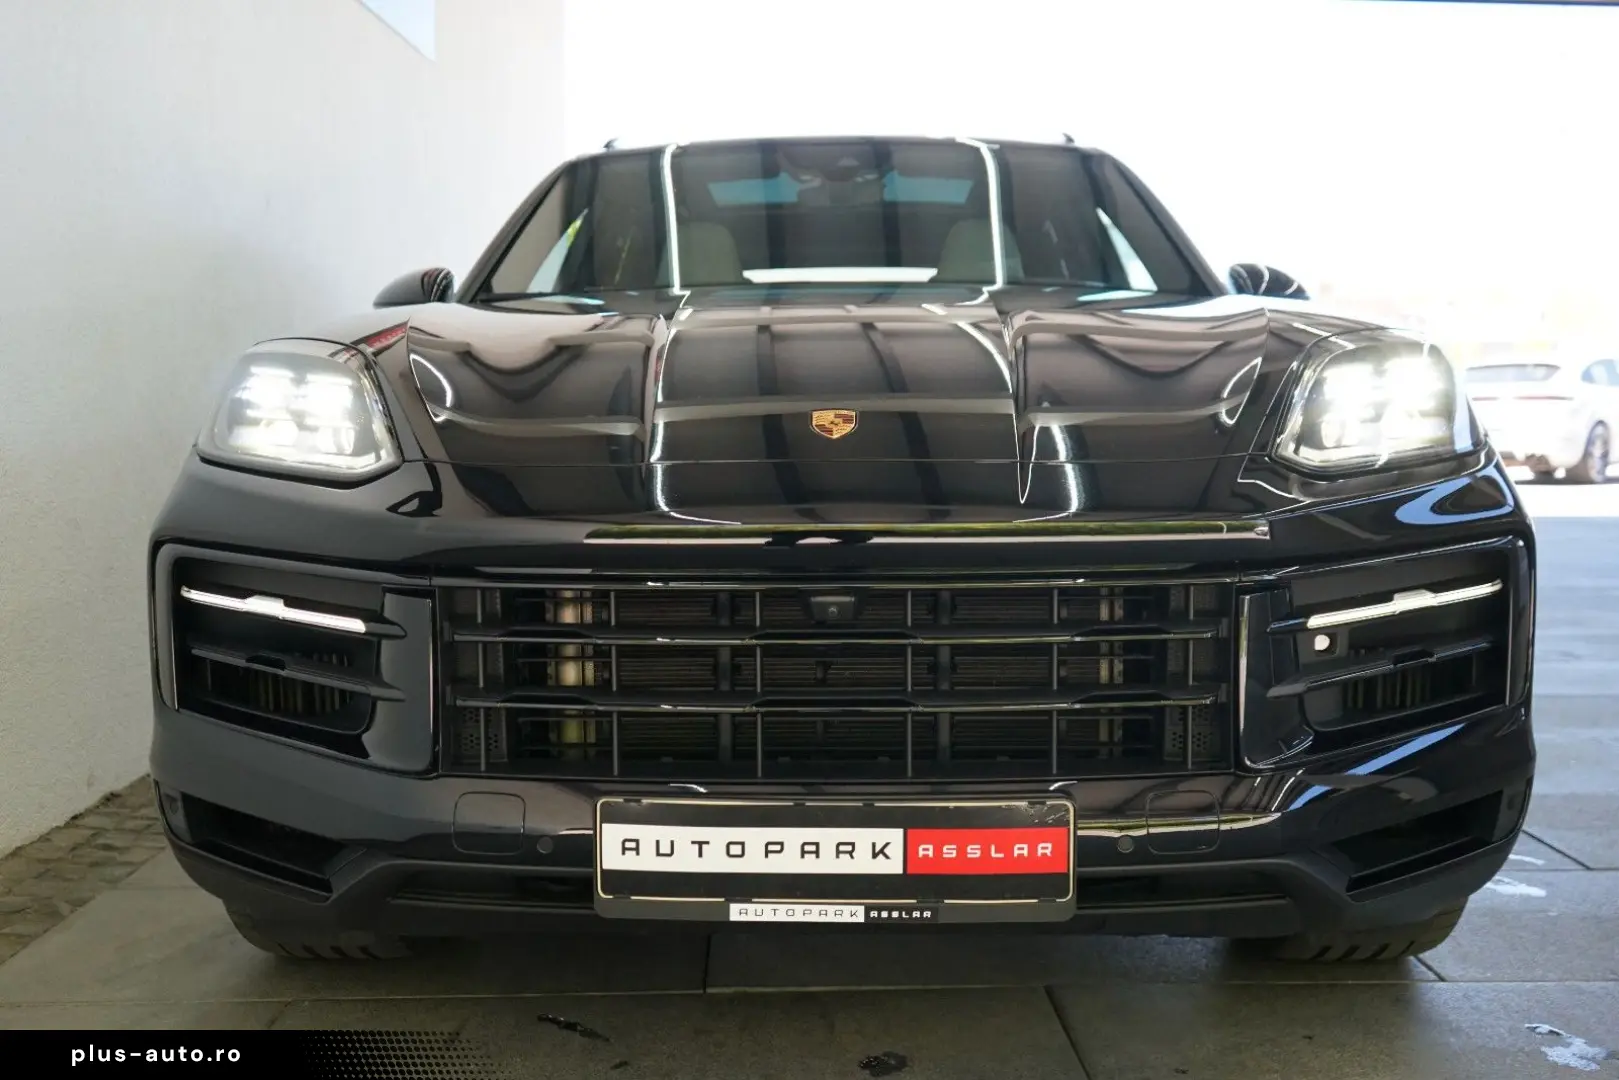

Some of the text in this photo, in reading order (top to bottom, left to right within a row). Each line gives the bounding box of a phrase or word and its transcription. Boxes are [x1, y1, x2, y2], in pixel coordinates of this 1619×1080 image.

[621, 838, 1053, 860] AUTOPARK ASSLAR
[739, 908, 932, 919] AUTOPARK ASSLAR
